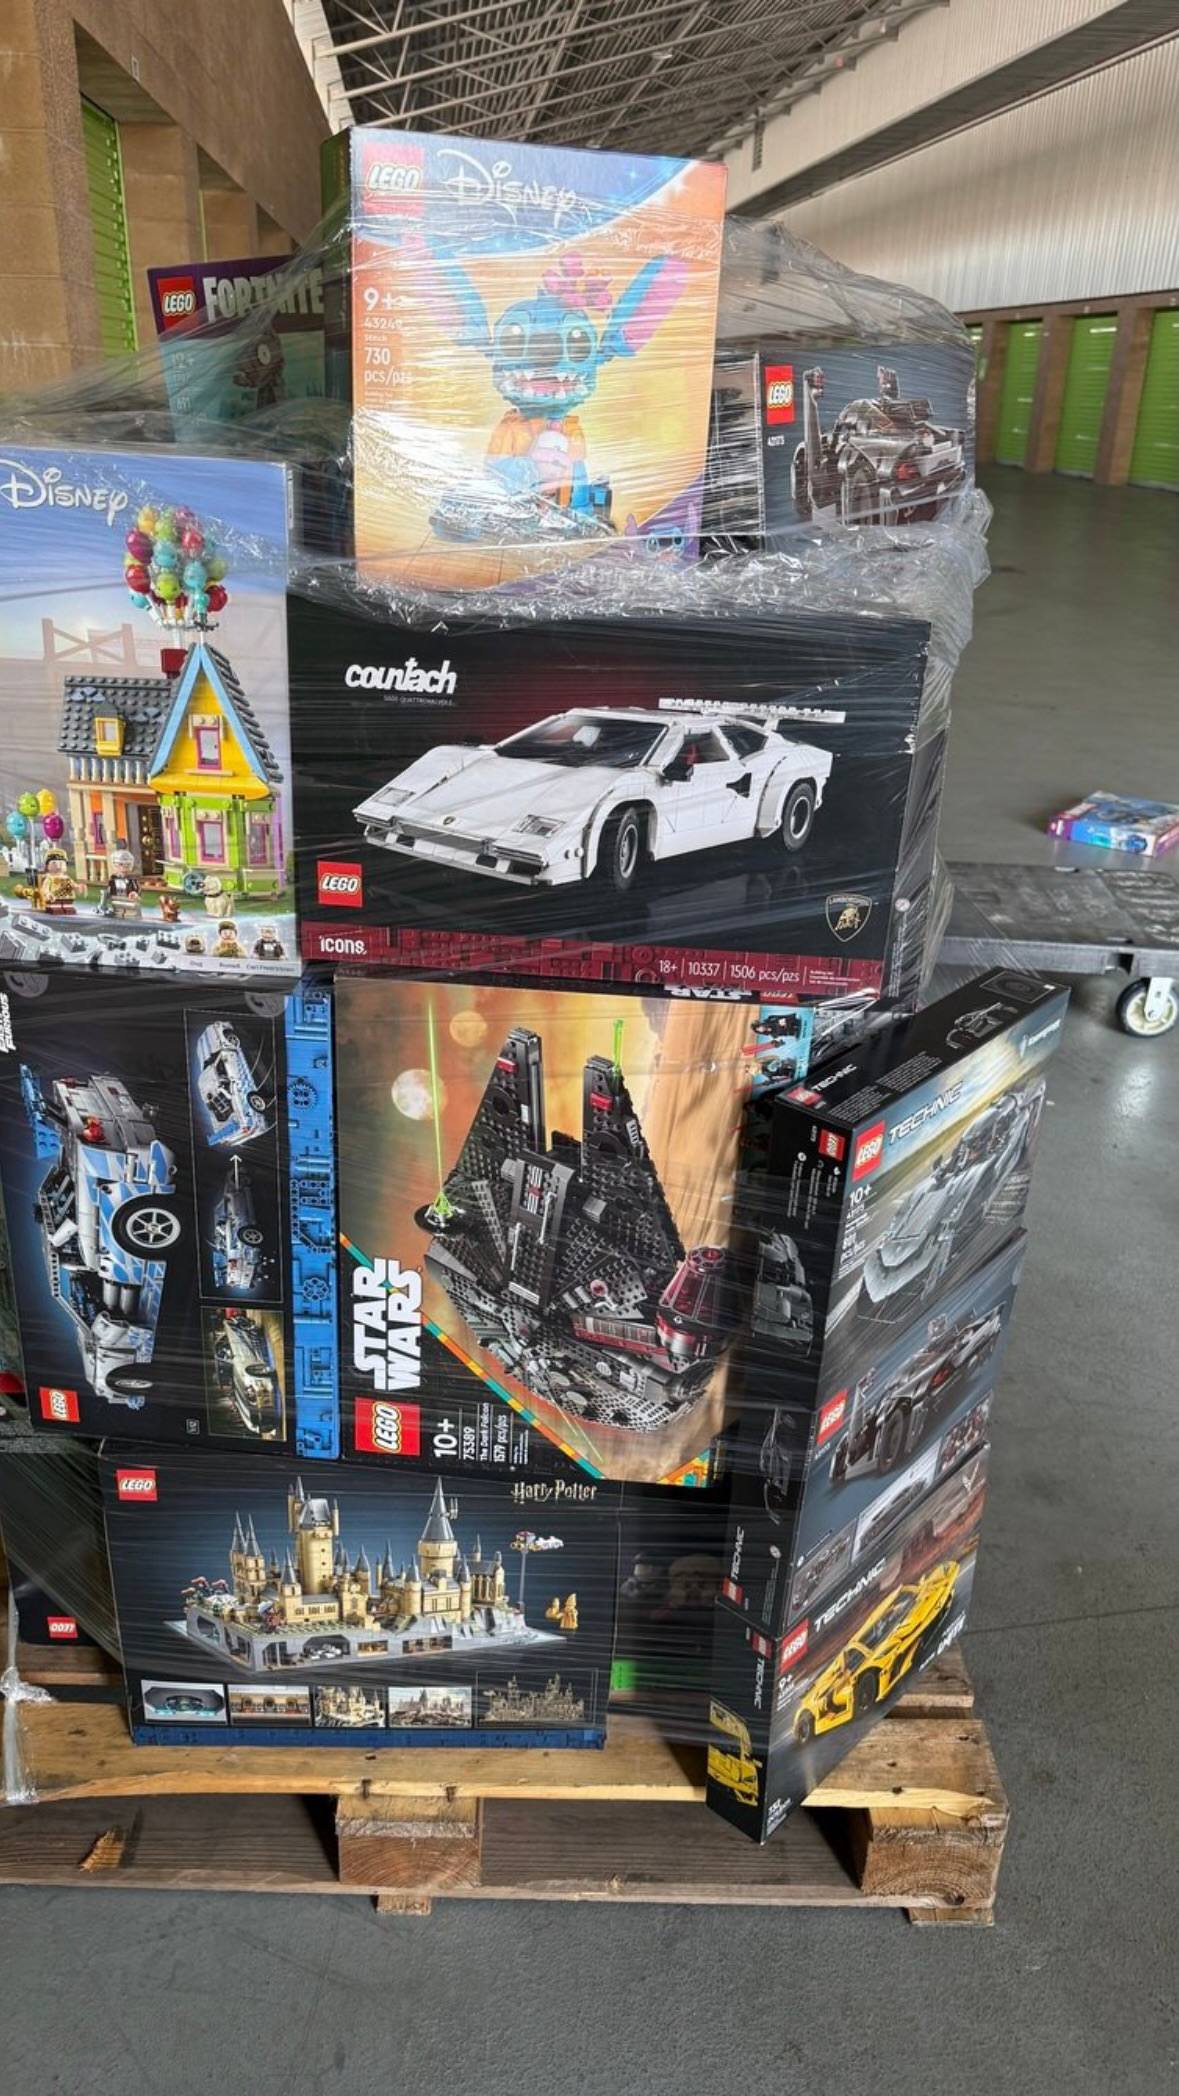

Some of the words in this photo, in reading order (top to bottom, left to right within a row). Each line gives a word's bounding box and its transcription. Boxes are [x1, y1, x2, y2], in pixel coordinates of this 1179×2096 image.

[367, 164, 421, 191] LEGO
[164, 293, 194, 314] LEGO
[364, 287, 393, 311] 9+
[364, 347, 391, 365] 730
[768, 383, 793, 408] LEGO
[345, 657, 457, 694] countach
[320, 876, 360, 893] LEGO
[659, 960, 678, 974] 18+
[688, 961, 720, 977] 10337
[730, 964, 756, 979] 1506
[759, 968, 800, 983] pcs/pzs
[812, 1064, 857, 1092] TECHNIC
[855, 1132, 884, 1169] LEGO
[850, 1184, 872, 1207] 10+
[353, 1257, 387, 1391] STAR
[388, 1258, 422, 1392] WARS
[52, 1389, 69, 1420] LEGO
[480, 1402, 489, 1428] Falcon
[375, 1402, 400, 1453] LEGO
[433, 1418, 457, 1458] 10+
[480, 1430, 488, 1447] Dark
[463, 1426, 475, 1461] 75389
[480, 1448, 488, 1461] The
[120, 1478, 155, 1491] LEGO
[510, 1480, 554, 1504] Harry
[555, 1479, 598, 1502] Potter
[814, 1557, 887, 1632] TECHNIC
[782, 1629, 808, 1664] LEGO
